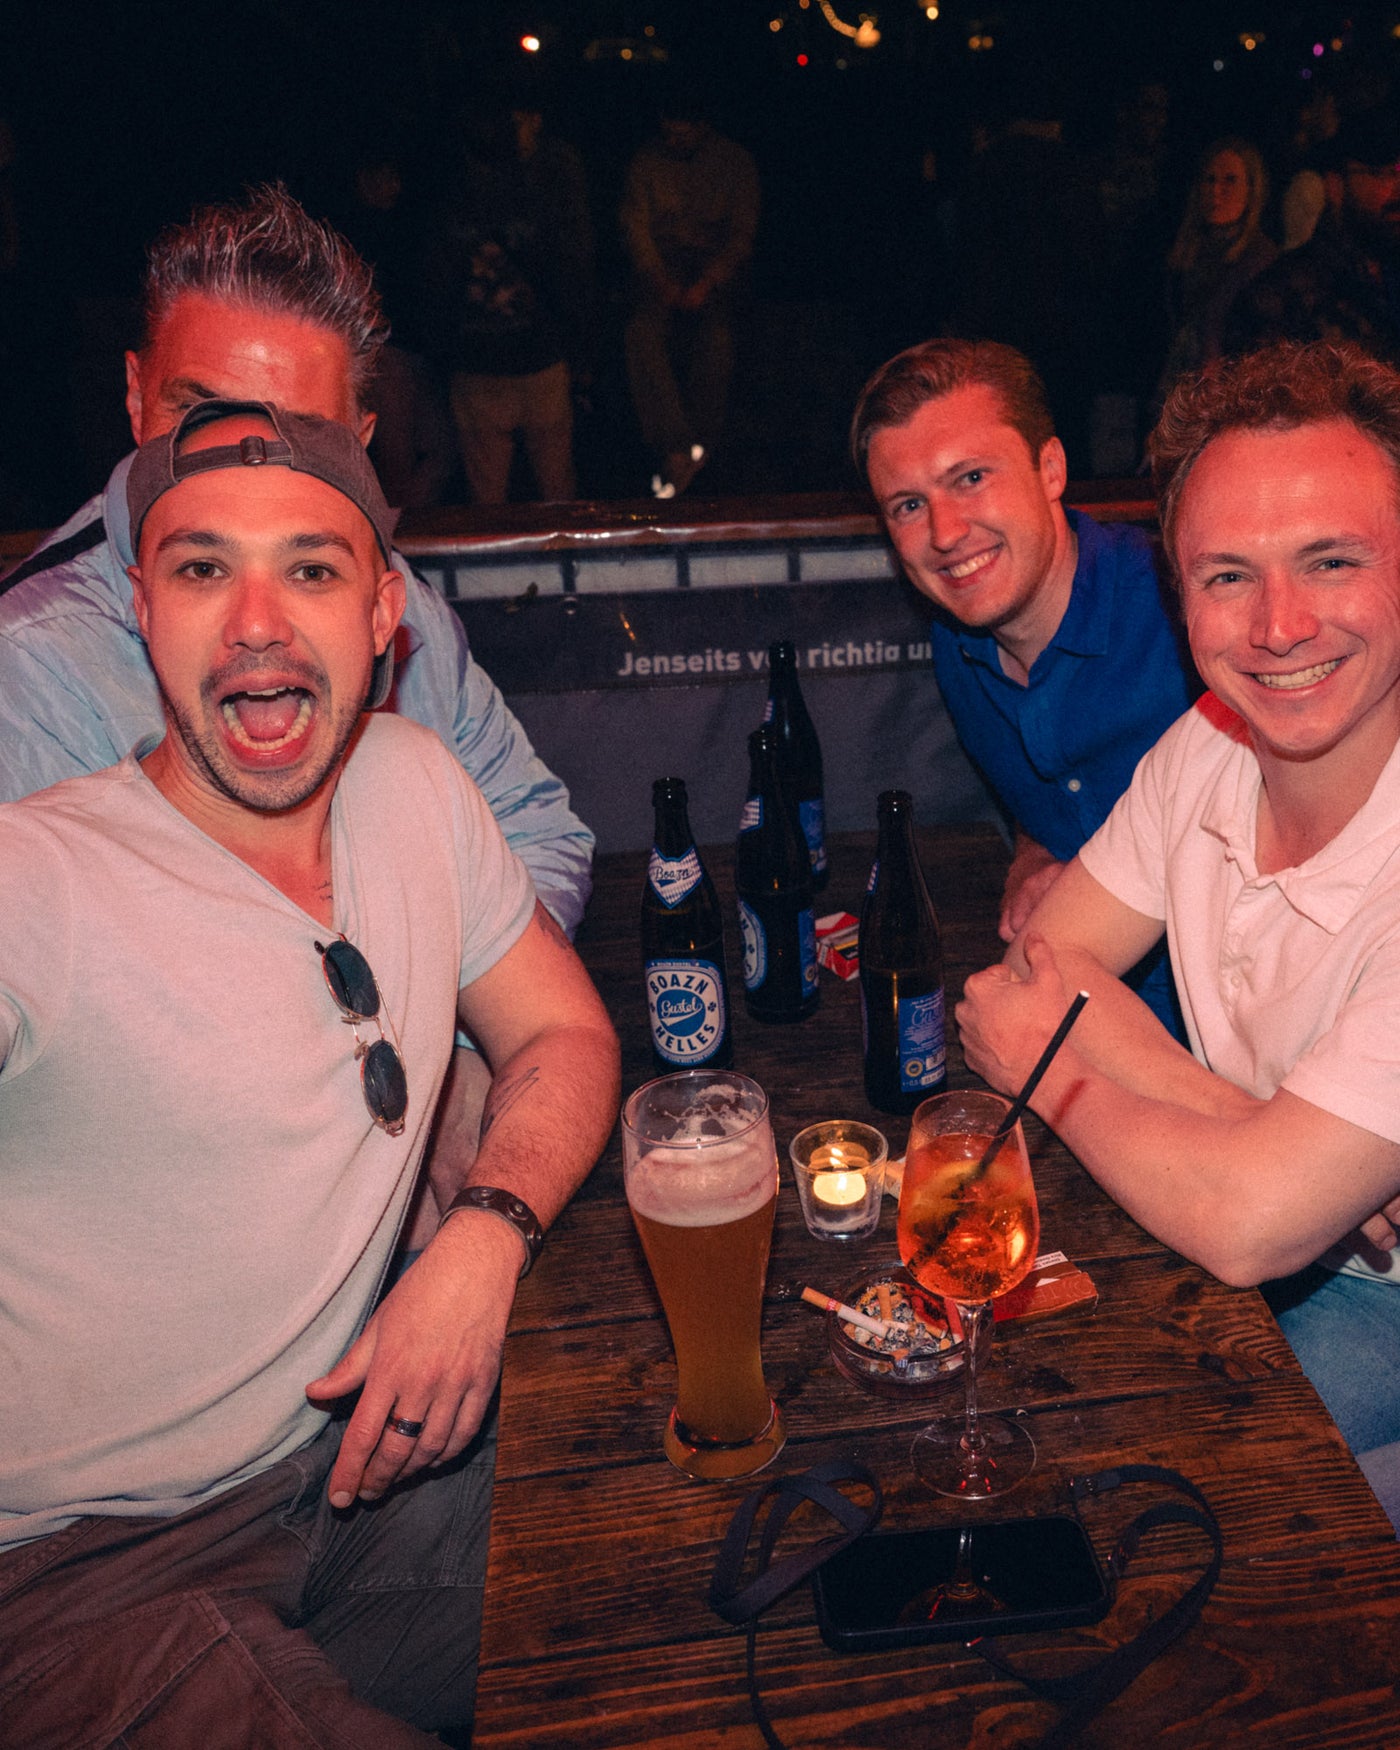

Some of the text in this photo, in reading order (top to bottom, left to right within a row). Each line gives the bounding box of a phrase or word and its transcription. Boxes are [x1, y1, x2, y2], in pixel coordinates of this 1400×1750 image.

[617, 647, 742, 676] Jenseits
[649, 973, 709, 995] BOAZN
[661, 996, 700, 1018] Gustel
[655, 1024, 715, 1052] HELLES
